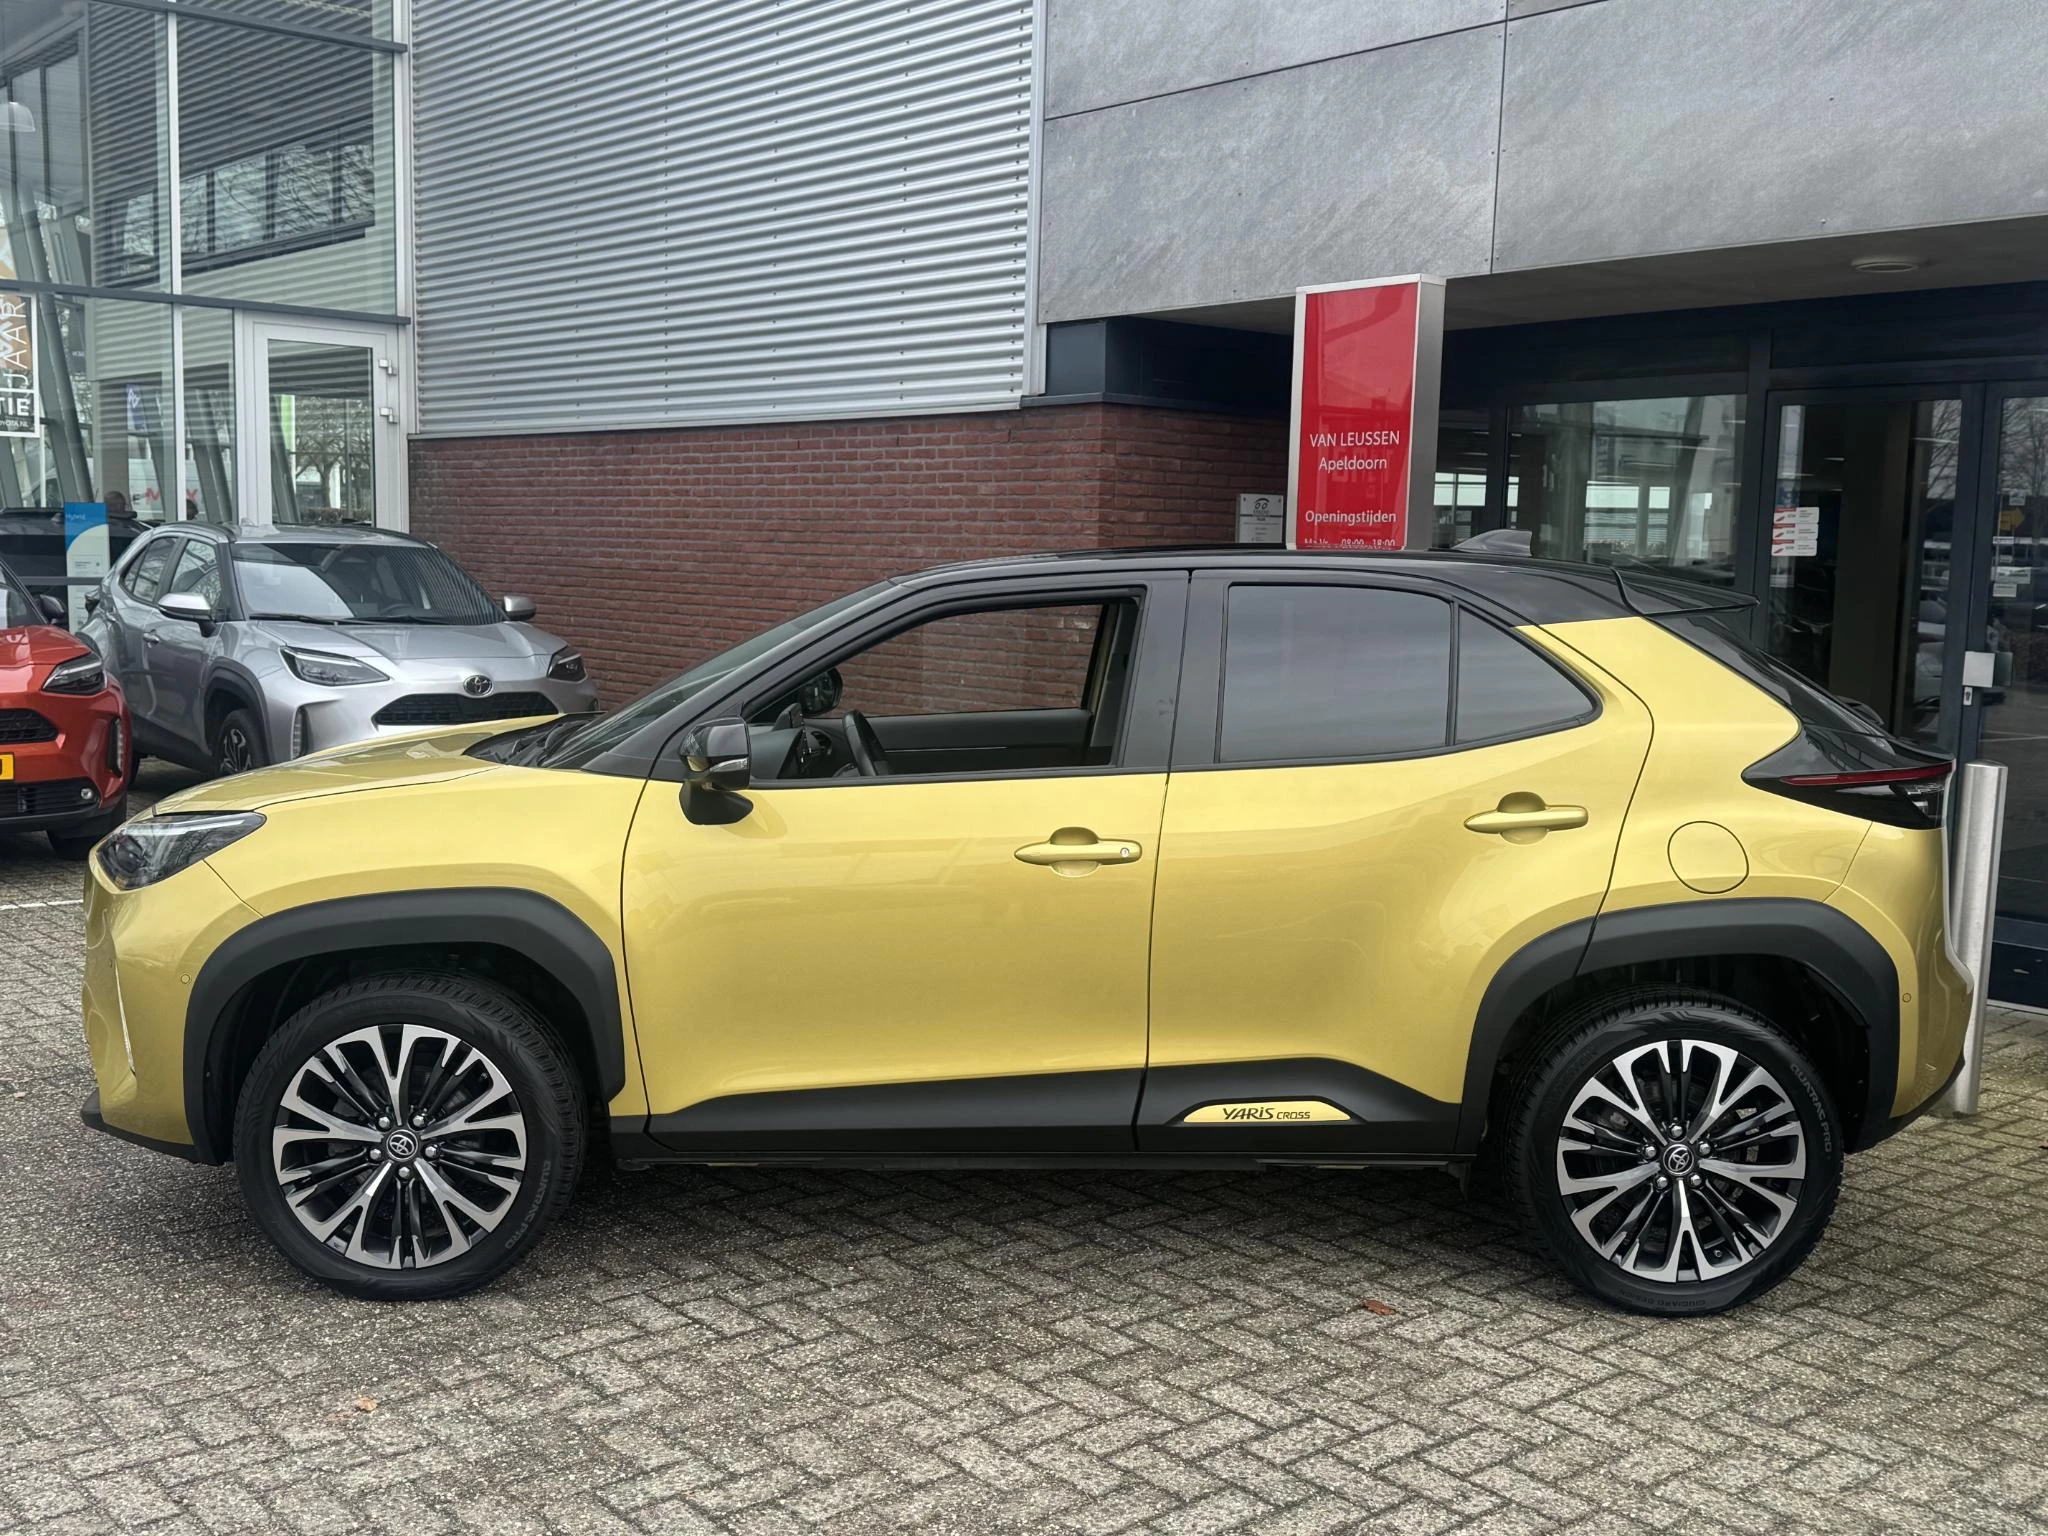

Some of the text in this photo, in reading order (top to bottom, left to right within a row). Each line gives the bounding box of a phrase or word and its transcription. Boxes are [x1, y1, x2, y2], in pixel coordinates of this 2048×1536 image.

[1, 302, 28, 386] JAAR
[1310, 430, 1400, 447] VAN LEUSSEN
[1319, 455, 1387, 474] Apeldoorn
[1305, 509, 1397, 526] Openingstijden
[1276, 1111, 1311, 1120] CROSS
[1821, 1121, 1833, 1153] PRO
